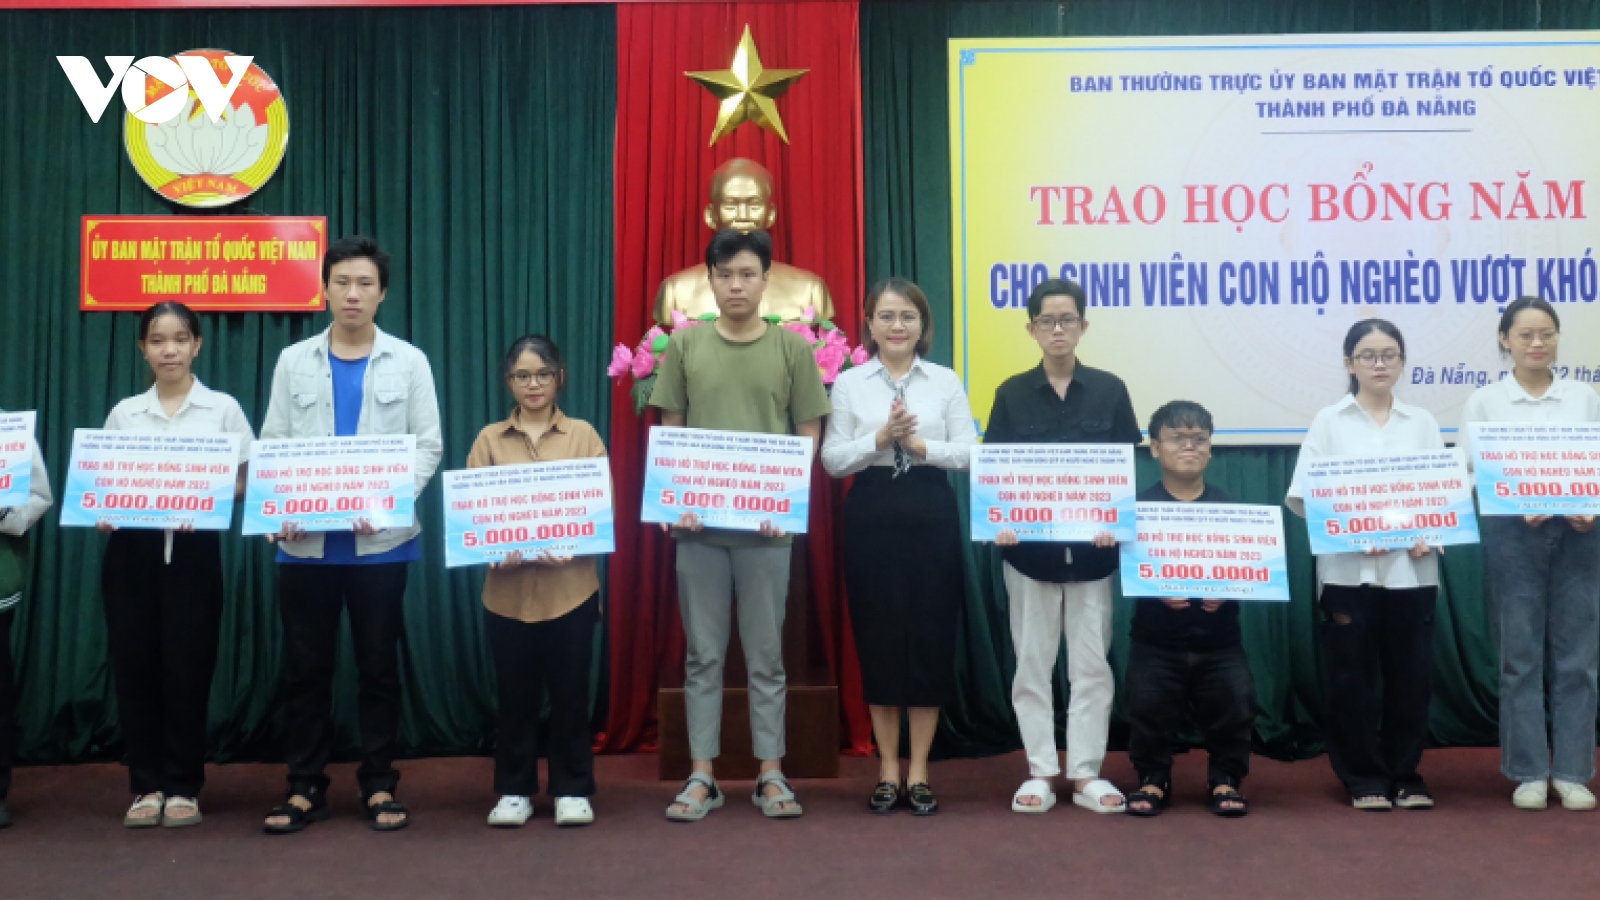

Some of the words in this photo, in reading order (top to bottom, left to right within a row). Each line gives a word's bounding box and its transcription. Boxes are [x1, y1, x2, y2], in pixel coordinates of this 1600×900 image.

[1070, 75, 1113, 92] BAN
[1120, 71, 1203, 91] THƯỜNG
[1209, 72, 1262, 94] TRỰC
[1270, 68, 1295, 90] ỦY
[1303, 73, 1346, 89] BAN
[1354, 68, 1398, 92] MẶT
[1406, 68, 1461, 91] TRẬN
[1467, 65, 1494, 88] TỔ
[1500, 65, 1557, 88] QUỐC
[1255, 98, 1325, 118] THÀNH
[1332, 95, 1374, 118] PHỐ
[1382, 96, 1410, 116] ĐÀ
[1416, 94, 1476, 116] NẴNG
[1030, 184, 1166, 225] TRAO
[1182, 183, 1290, 233] HỌC
[1308, 161, 1452, 222] BỔNG
[1469, 170, 1586, 220] NĂM
[92, 234, 108, 260] ỦY
[112, 240, 137, 260] BAN
[141, 236, 166, 264] MẶT
[170, 237, 201, 264] TRẬN
[205, 233, 221, 260] TỔ
[223, 233, 255, 262] QUỐC
[259, 237, 284, 264] VIỆT
[287, 240, 316, 260] NAM
[141, 270, 181, 294] THÀNH
[185, 267, 208, 294] PHỐ
[212, 270, 228, 294] ĐÀ
[232, 267, 267, 294] NẴNG
[1140, 252, 1208, 306] VIÊN
[1219, 261, 1280, 306] CON
[1290, 250, 1329, 315] HỘ
[1340, 250, 1440, 304] NGHÈO
[1450, 254, 1526, 313] VƯỢT
[1411, 366, 1434, 384] Đà
[185, 463, 207, 473] SINH
[363, 465, 384, 473] SINH
[760, 465, 781, 475] SINH
[1503, 468, 1522, 476] CON
[95, 478, 114, 487] CON
[672, 475, 691, 485] CON
[1083, 475, 1105, 485] SINH
[274, 484, 292, 493] CON
[1417, 481, 1438, 491] SINH
[559, 491, 580, 500] SINH
[998, 491, 1016, 501] CON
[1333, 503, 1352, 512] CON
[473, 514, 491, 524] CON
[1233, 535, 1254, 543] SINH
[1148, 548, 1165, 558] CON
